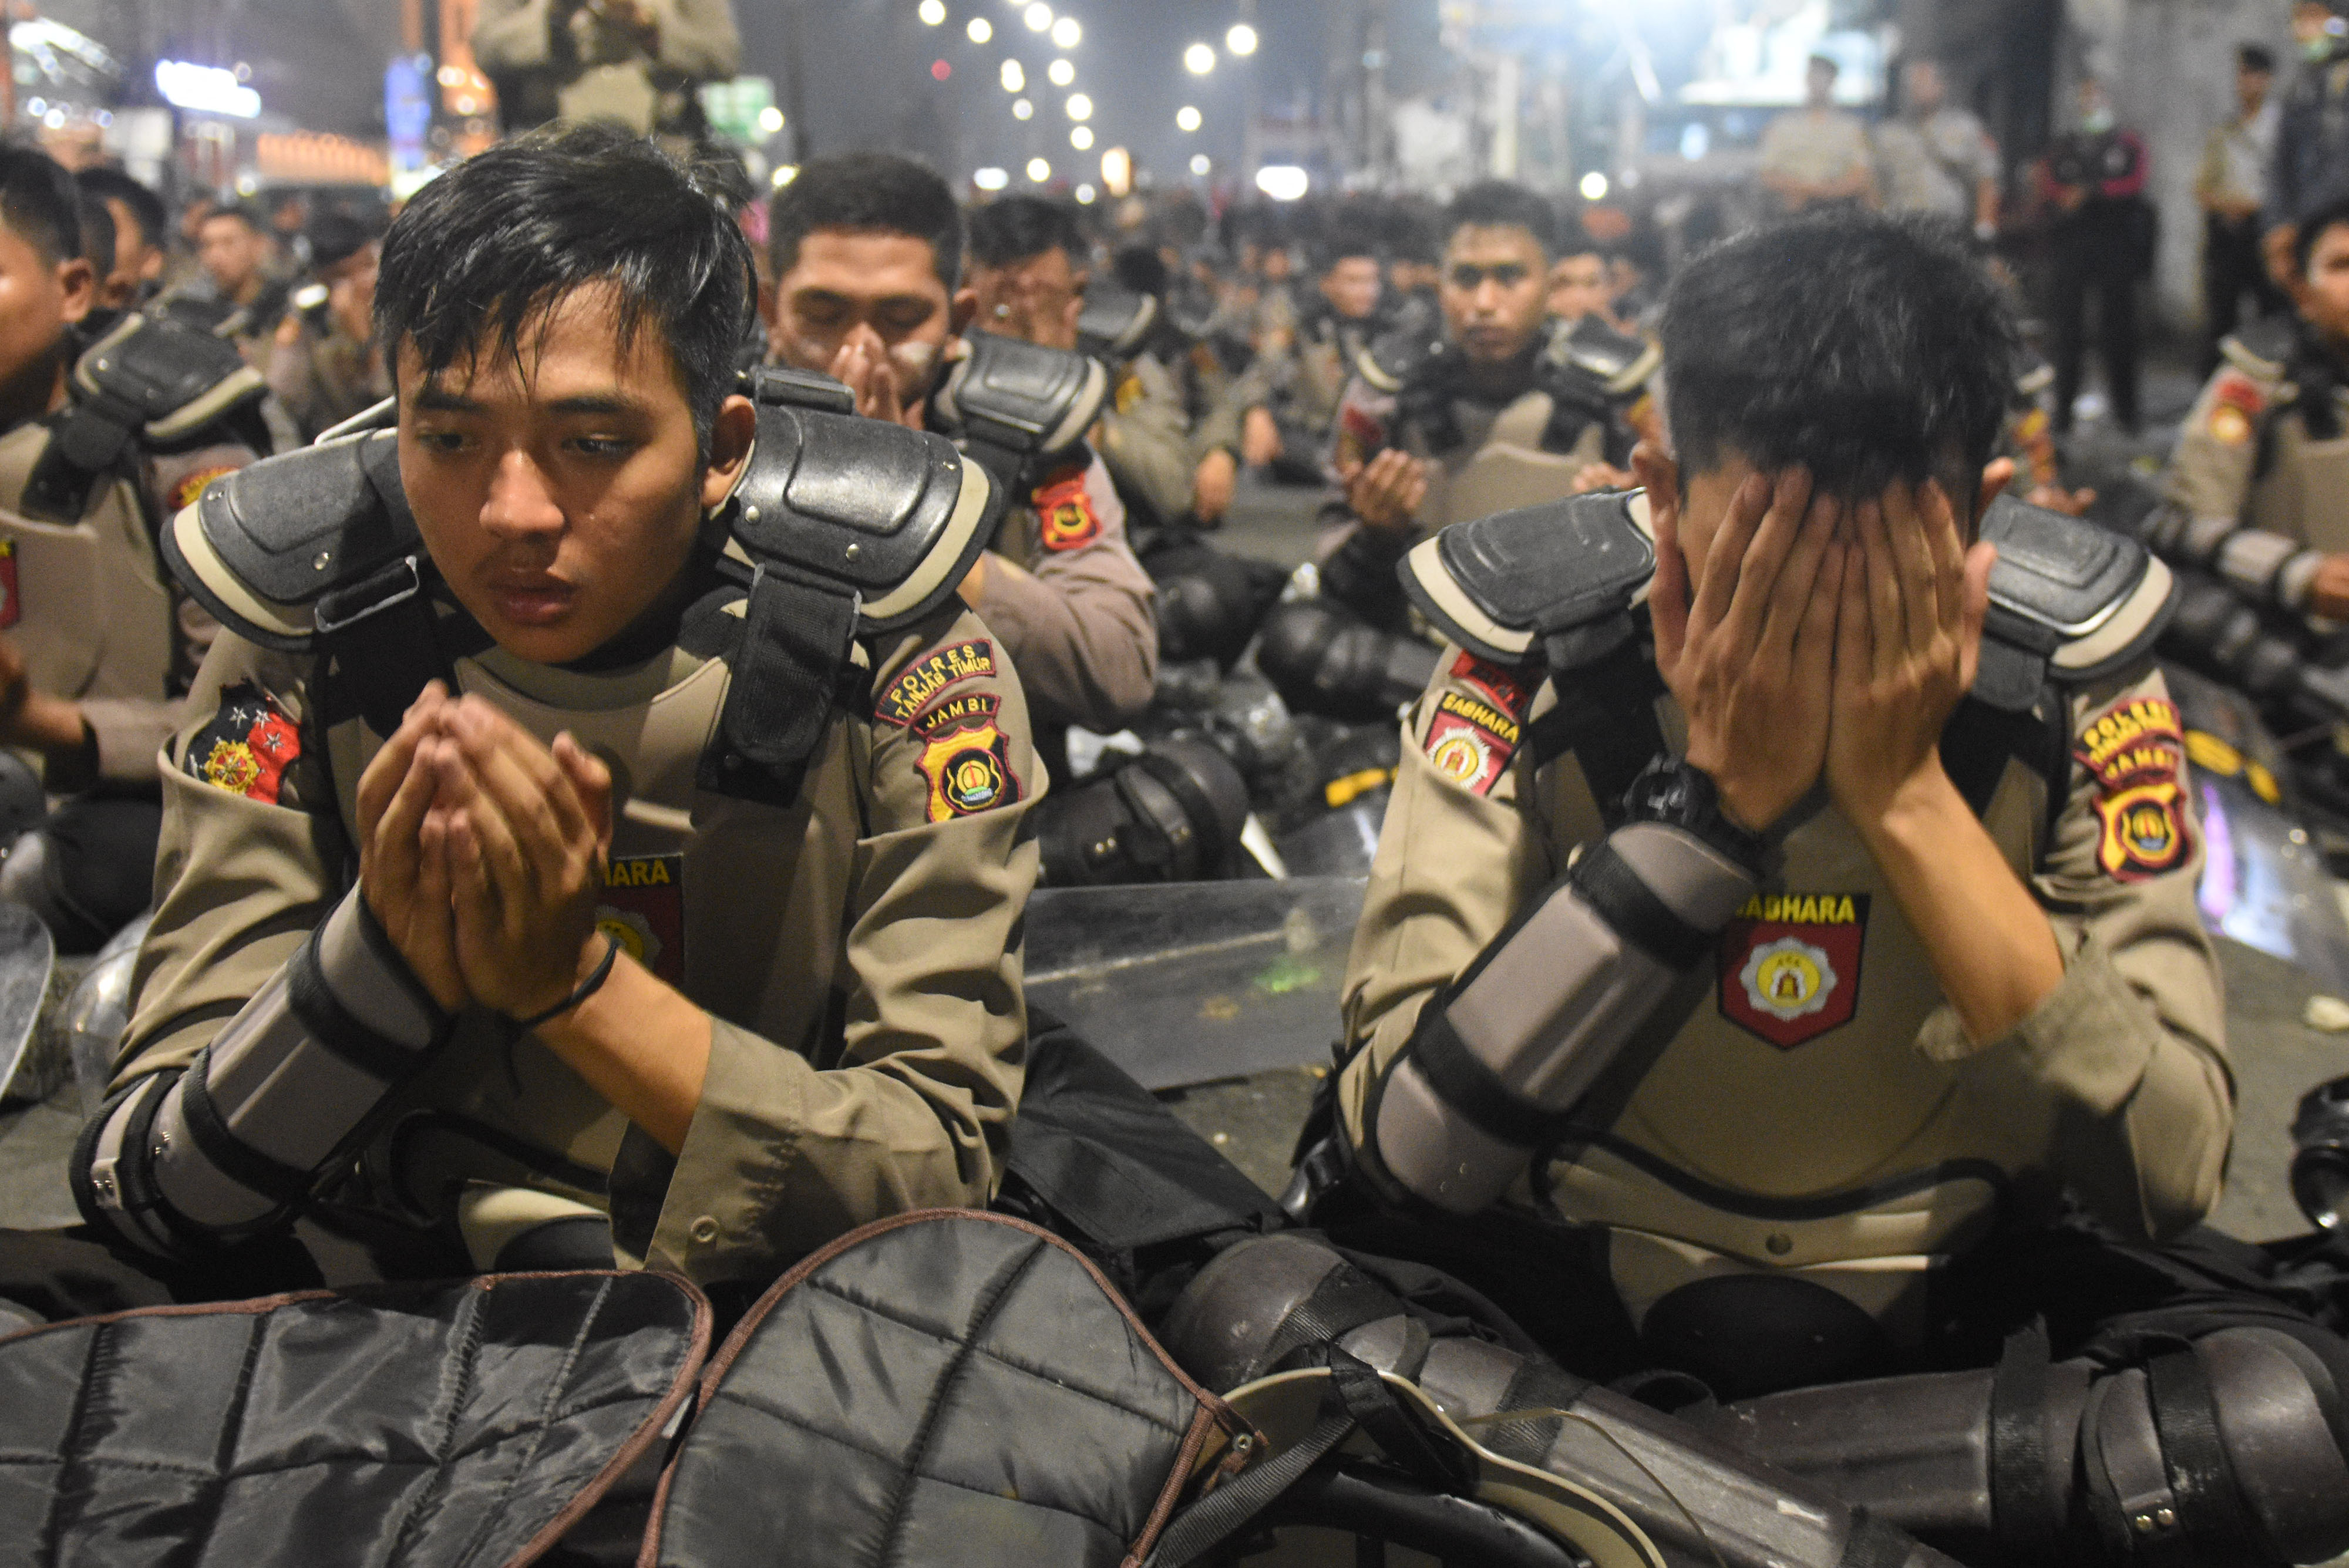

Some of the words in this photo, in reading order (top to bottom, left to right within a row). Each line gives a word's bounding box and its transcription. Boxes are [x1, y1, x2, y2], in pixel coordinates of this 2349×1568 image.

[890, 644, 975, 704] POLRES
[896, 673, 947, 718] TANJAB
[947, 657, 991, 678] TIMUR
[927, 697, 987, 728] JAMBI
[1442, 693, 1520, 744] SABHARA
